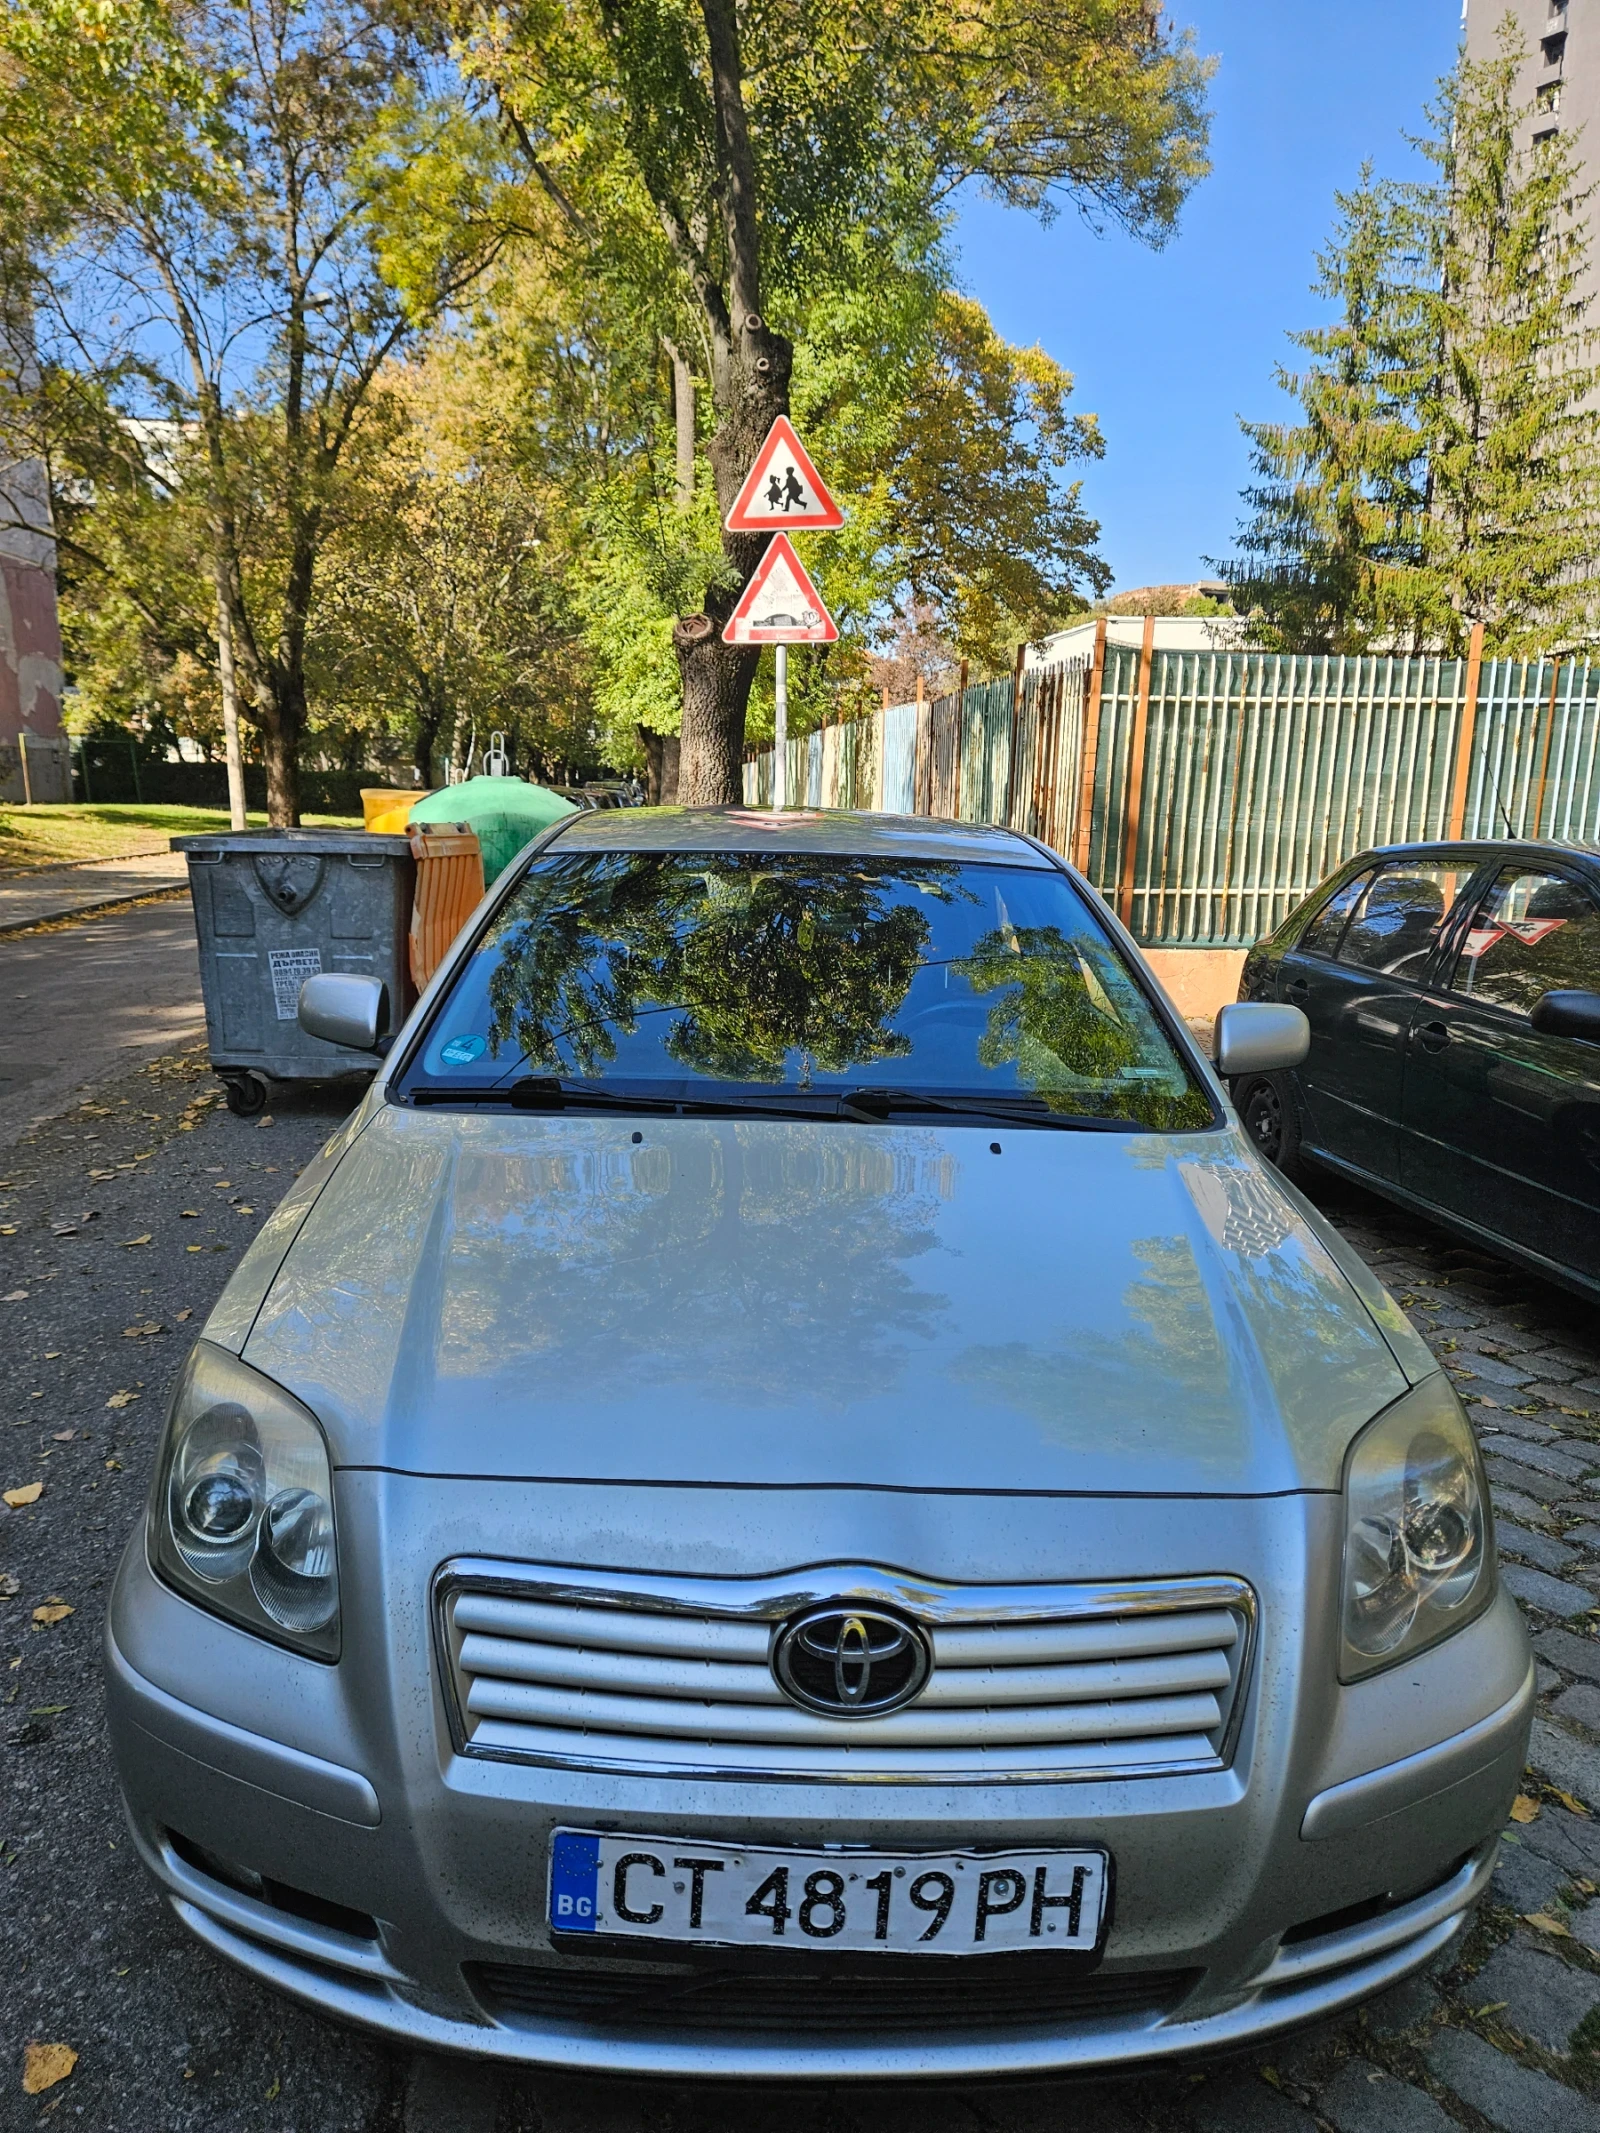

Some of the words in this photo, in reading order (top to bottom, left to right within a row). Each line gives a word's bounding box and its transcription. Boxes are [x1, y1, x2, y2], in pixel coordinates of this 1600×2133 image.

[271, 951, 291, 960] РЕЖА
[272, 958, 320, 968] ДЪРВЕТА
[557, 1893, 592, 1917] BG
[614, 1852, 725, 1930] CT
[744, 1866, 957, 1942] 4819
[973, 1865, 1087, 1943] PH
